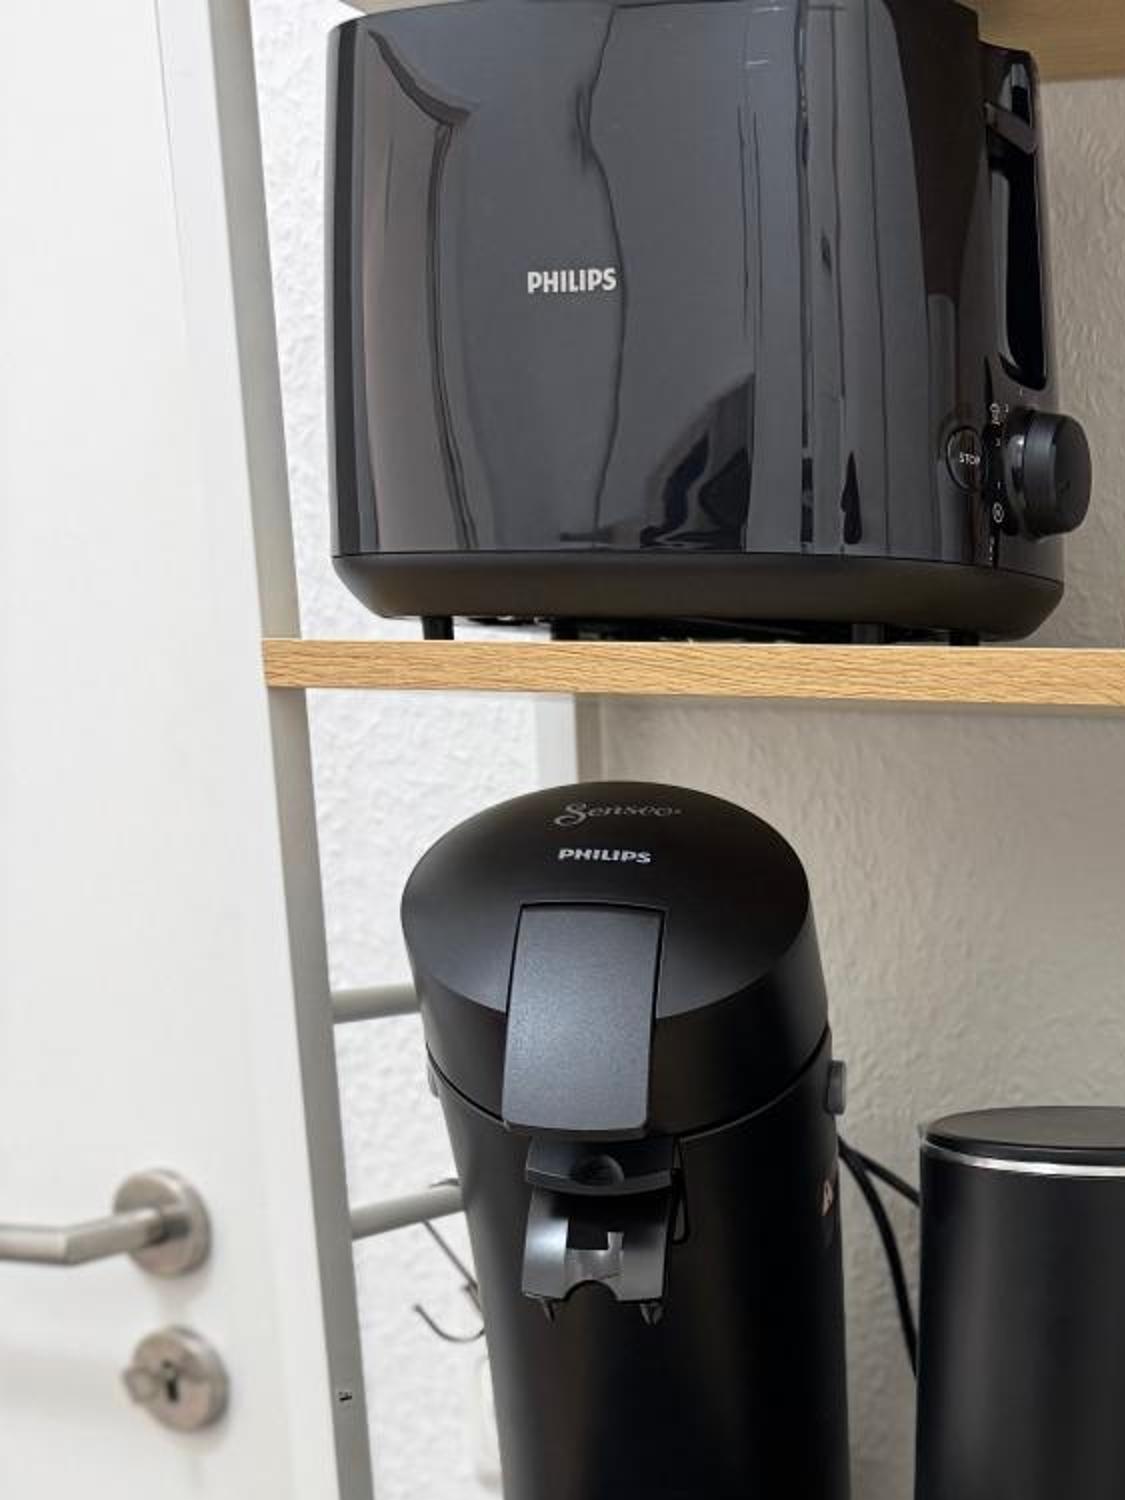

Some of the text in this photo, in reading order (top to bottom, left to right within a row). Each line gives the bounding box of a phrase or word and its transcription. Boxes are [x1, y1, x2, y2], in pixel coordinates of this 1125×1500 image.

[527, 267, 617, 293] PHILIPS
[959, 452, 981, 465] STOP
[558, 848, 652, 864] PHILIPS
